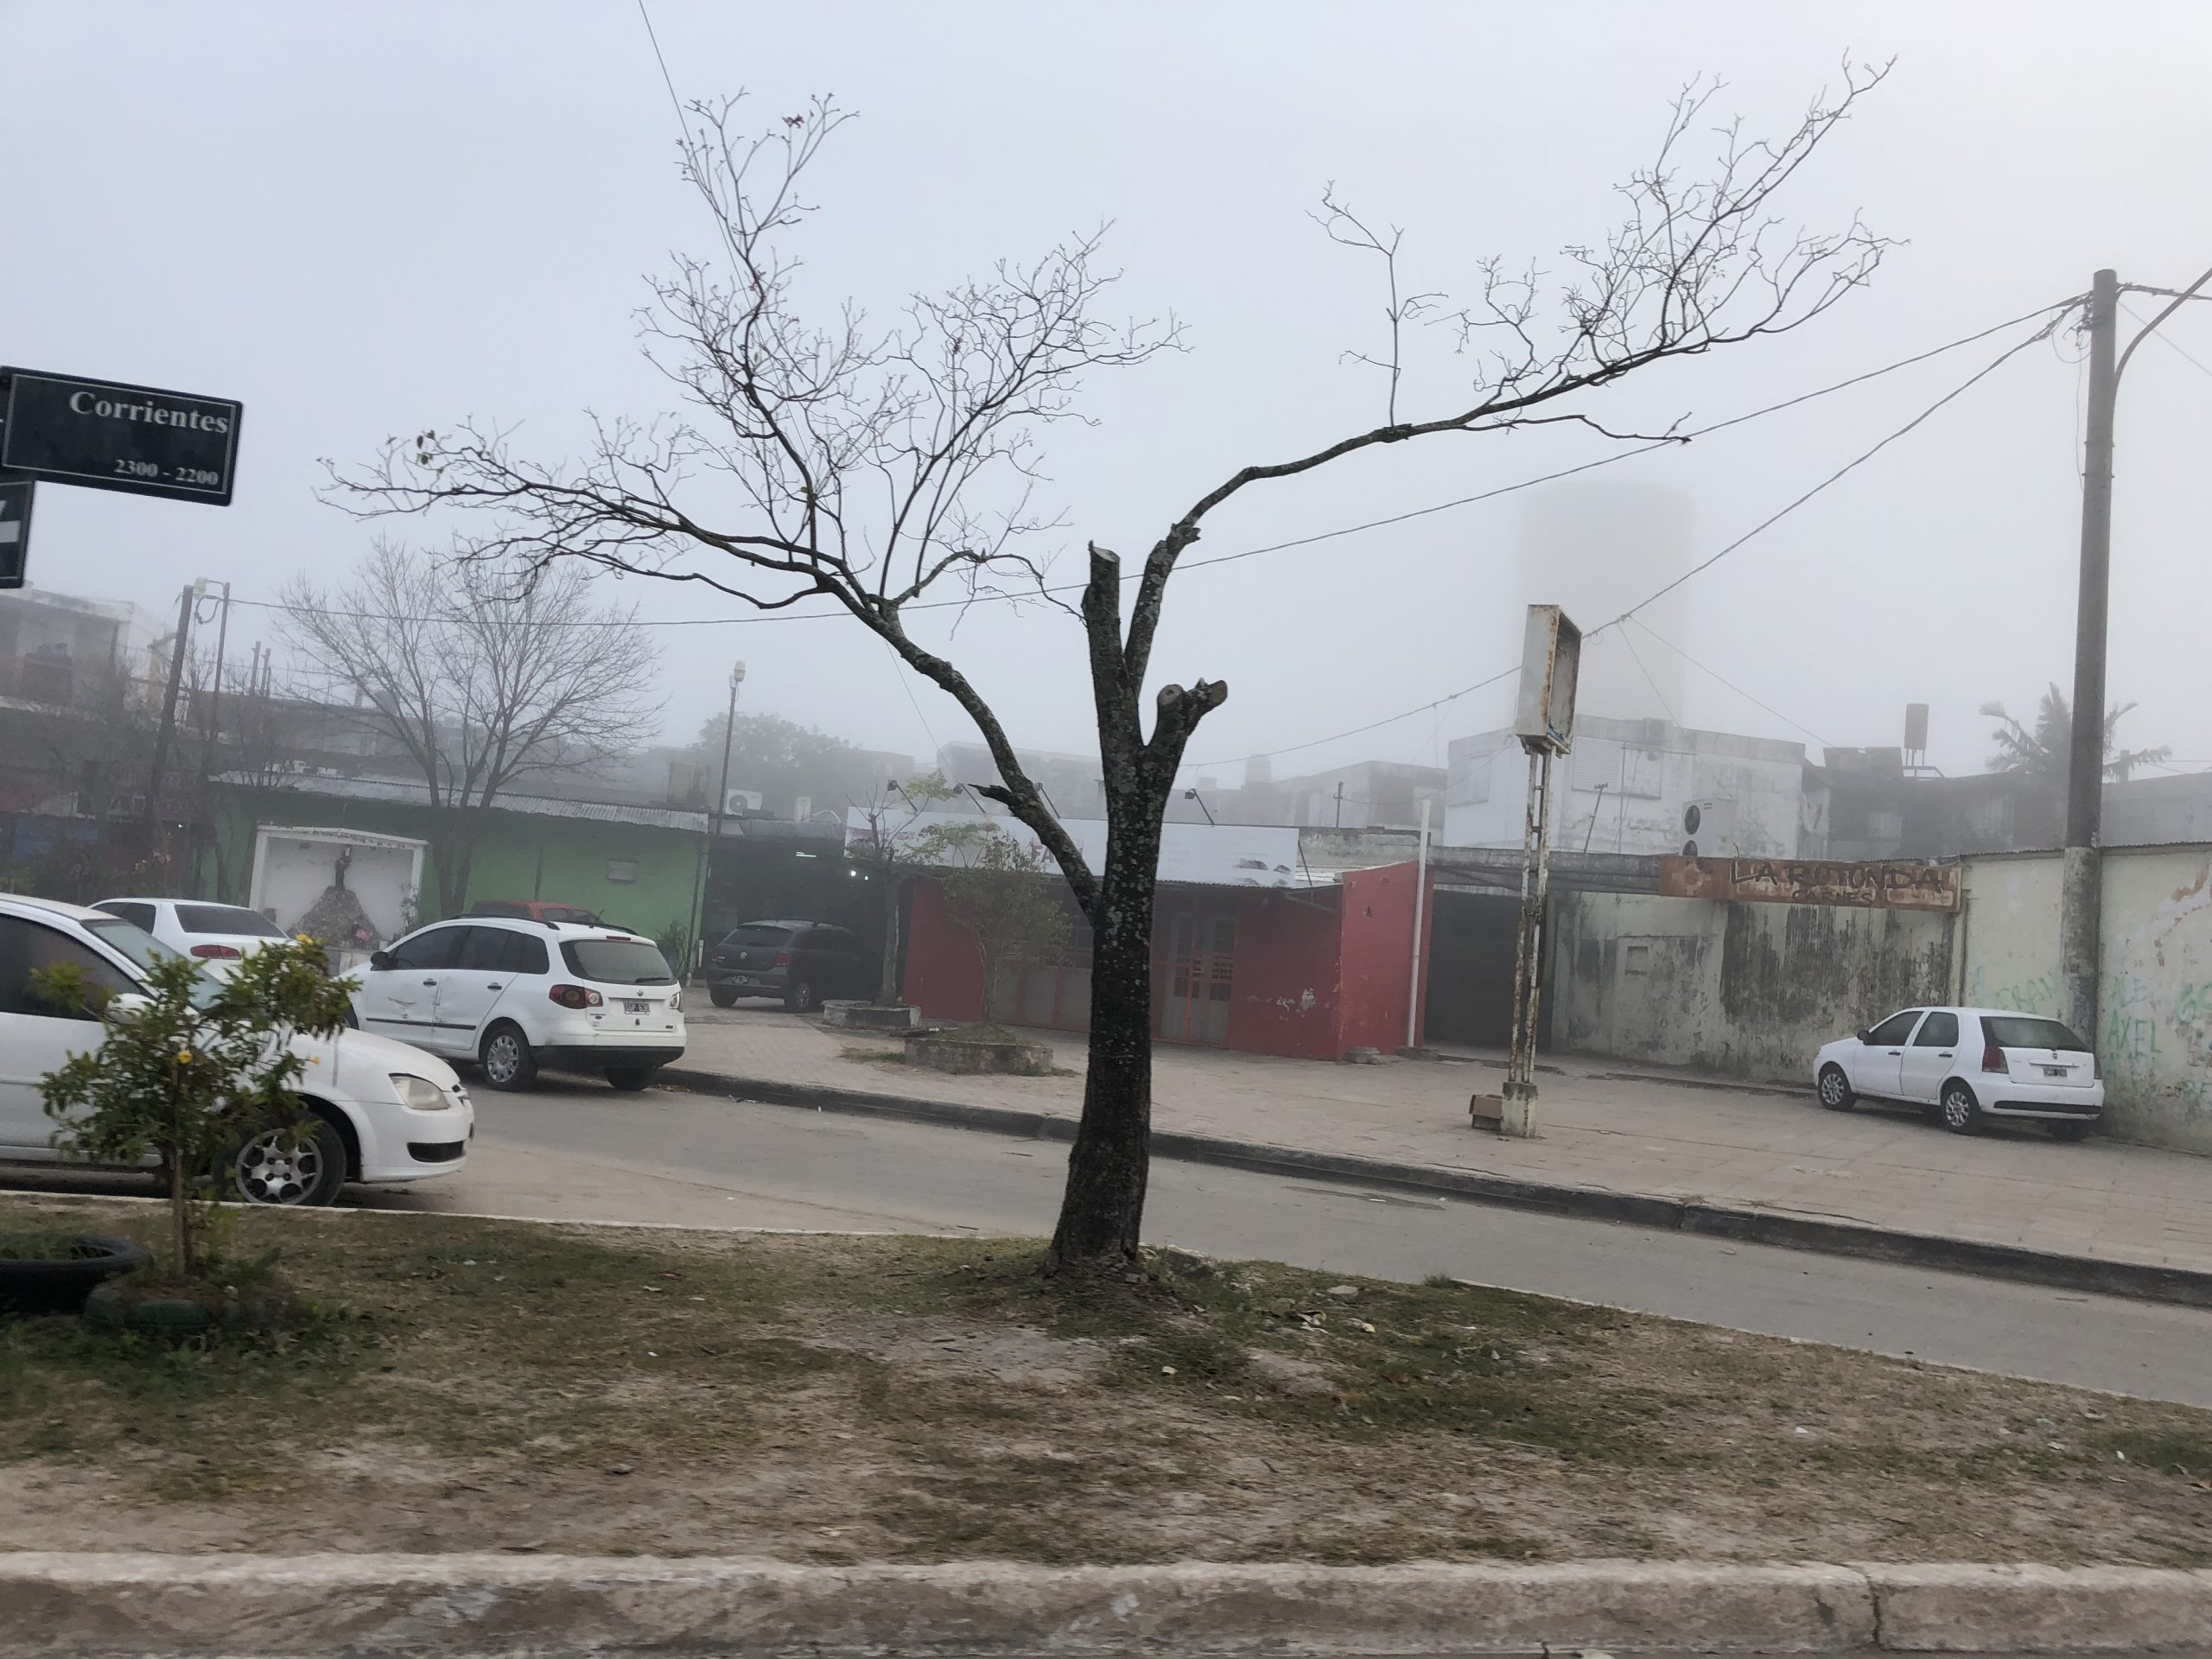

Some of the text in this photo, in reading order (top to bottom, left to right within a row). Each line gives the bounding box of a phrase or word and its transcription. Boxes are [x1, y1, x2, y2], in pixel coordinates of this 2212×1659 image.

[68, 391, 230, 434] Corrientes
[113, 459, 159, 478] 2300
[175, 467, 219, 486] 2200
[1731, 858, 1778, 887] LA
[1791, 888, 1875, 907] CARNES
[2107, 1010, 2164, 1057] AXEL
